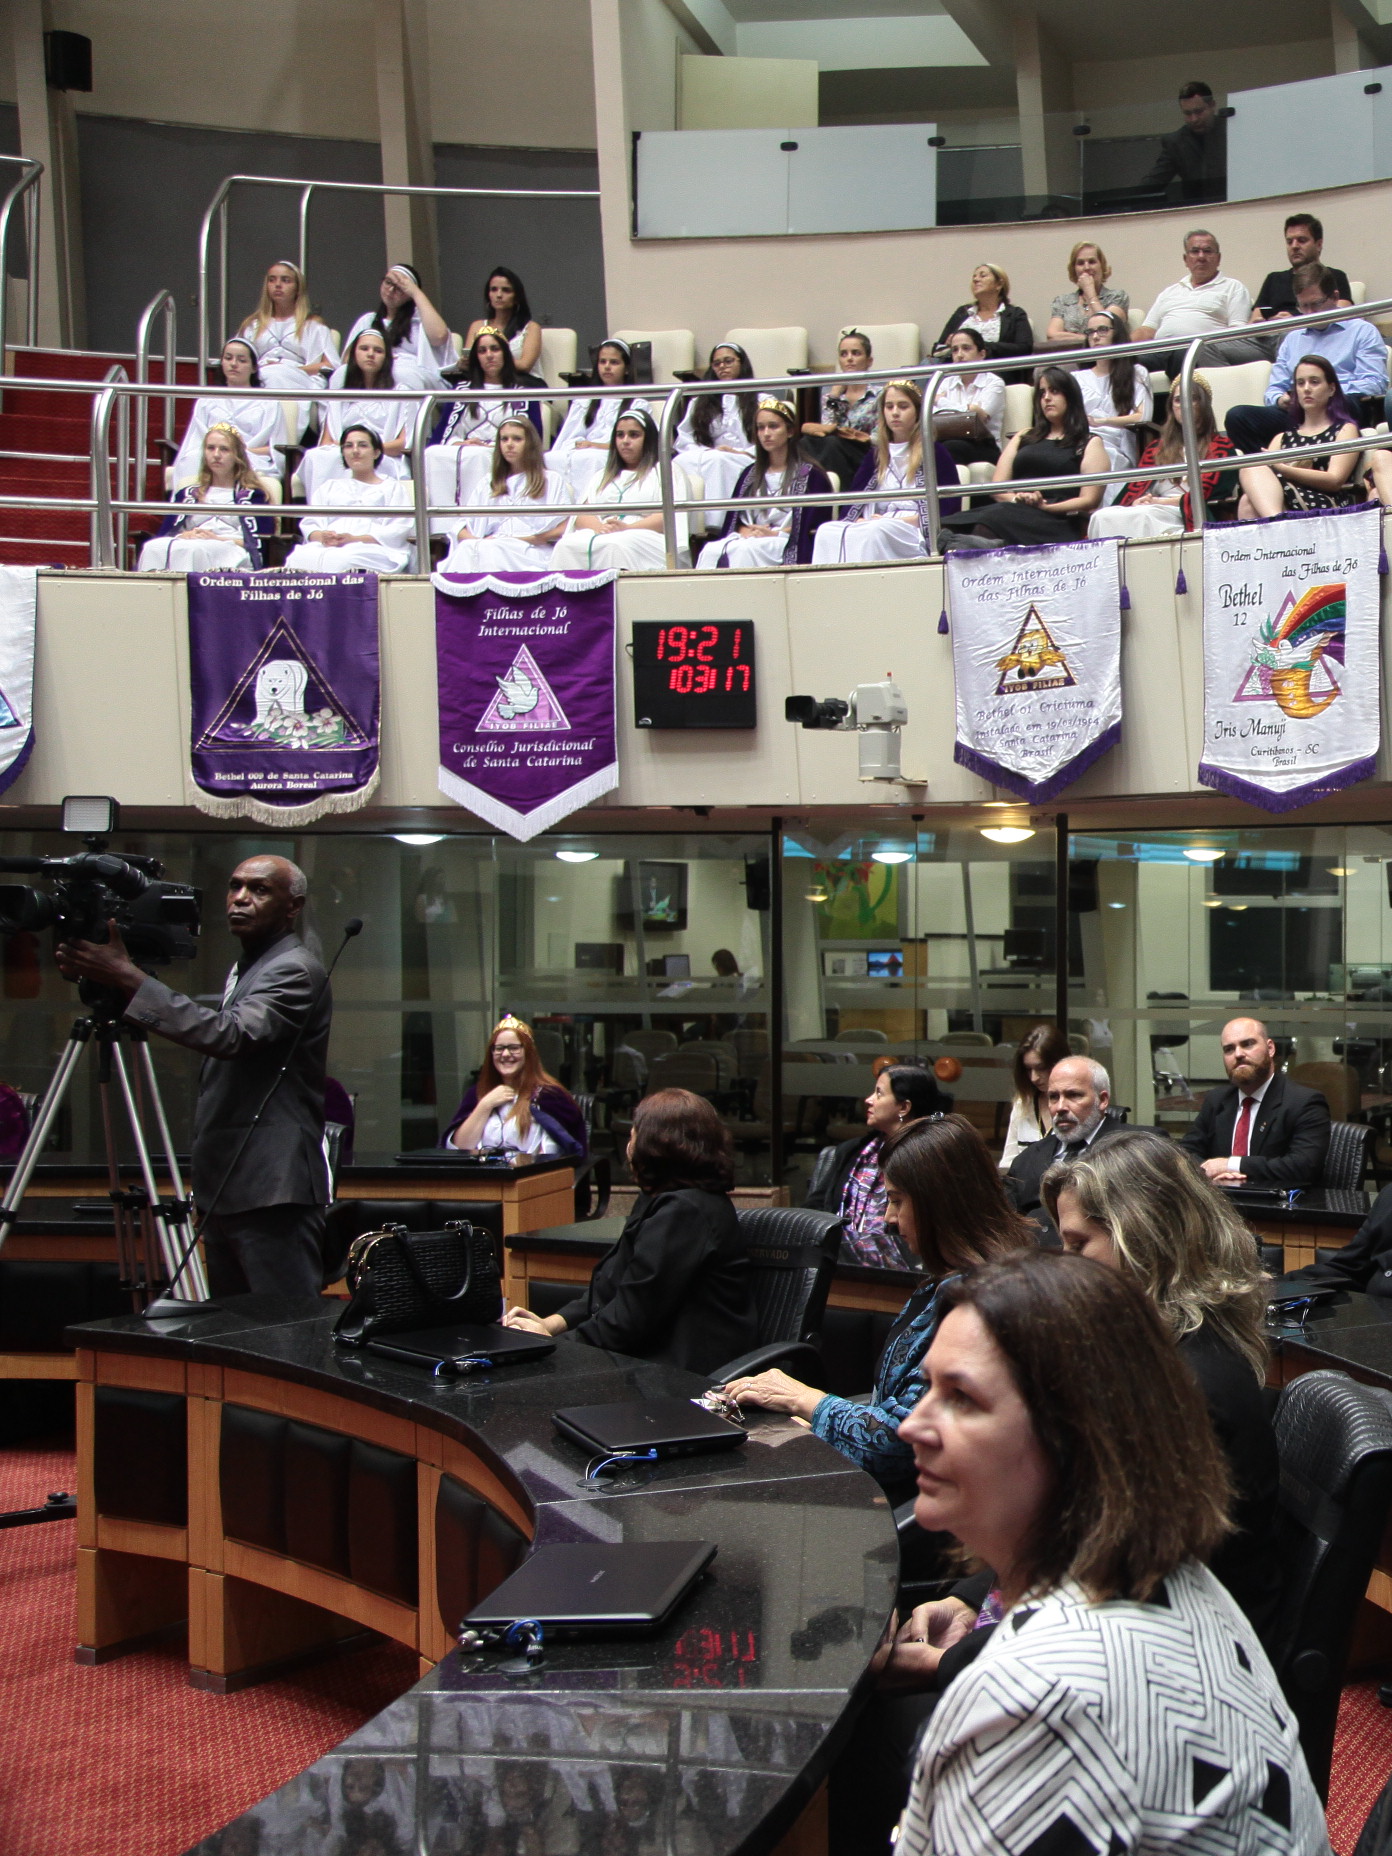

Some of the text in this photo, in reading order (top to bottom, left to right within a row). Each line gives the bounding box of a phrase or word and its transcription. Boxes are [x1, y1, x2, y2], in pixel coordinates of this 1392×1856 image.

[1220, 543, 1317, 564] Ordem Internacional
[961, 555, 1100, 589] Ordem Internacional
[1281, 557, 1359, 580] das Filhas de Jó
[200, 574, 365, 588] Ordem Internacional das
[240, 588, 324, 601] Filhas de Jó
[977, 576, 1087, 603] das Filhas de Jó
[1218, 582, 1264, 609] Bethel
[483, 605, 568, 622] Filhas de Jó
[1232, 612, 1248, 627] 12
[478, 621, 571, 637] Internacional
[657, 625, 742, 662] 19:21
[1004, 679, 1065, 693] IYOB FILIAE
[976, 704, 1016, 721] Bethel
[975, 723, 1021, 740] Instalado
[1026, 723, 1043, 731] em
[1214, 720, 1237, 739] Iris
[453, 738, 597, 754] Conselho Jurisdicional
[999, 730, 1079, 748] Santa Catarina
[1020, 745, 1055, 758] Brasil
[1304, 743, 1320, 755] SC
[463, 755, 583, 768] de Santa Catarina
[1272, 756, 1297, 767] Brasil
[214, 771, 354, 780] Bethel 009 de Santa Catarina
[250, 781, 317, 789] Aurora Boreal
